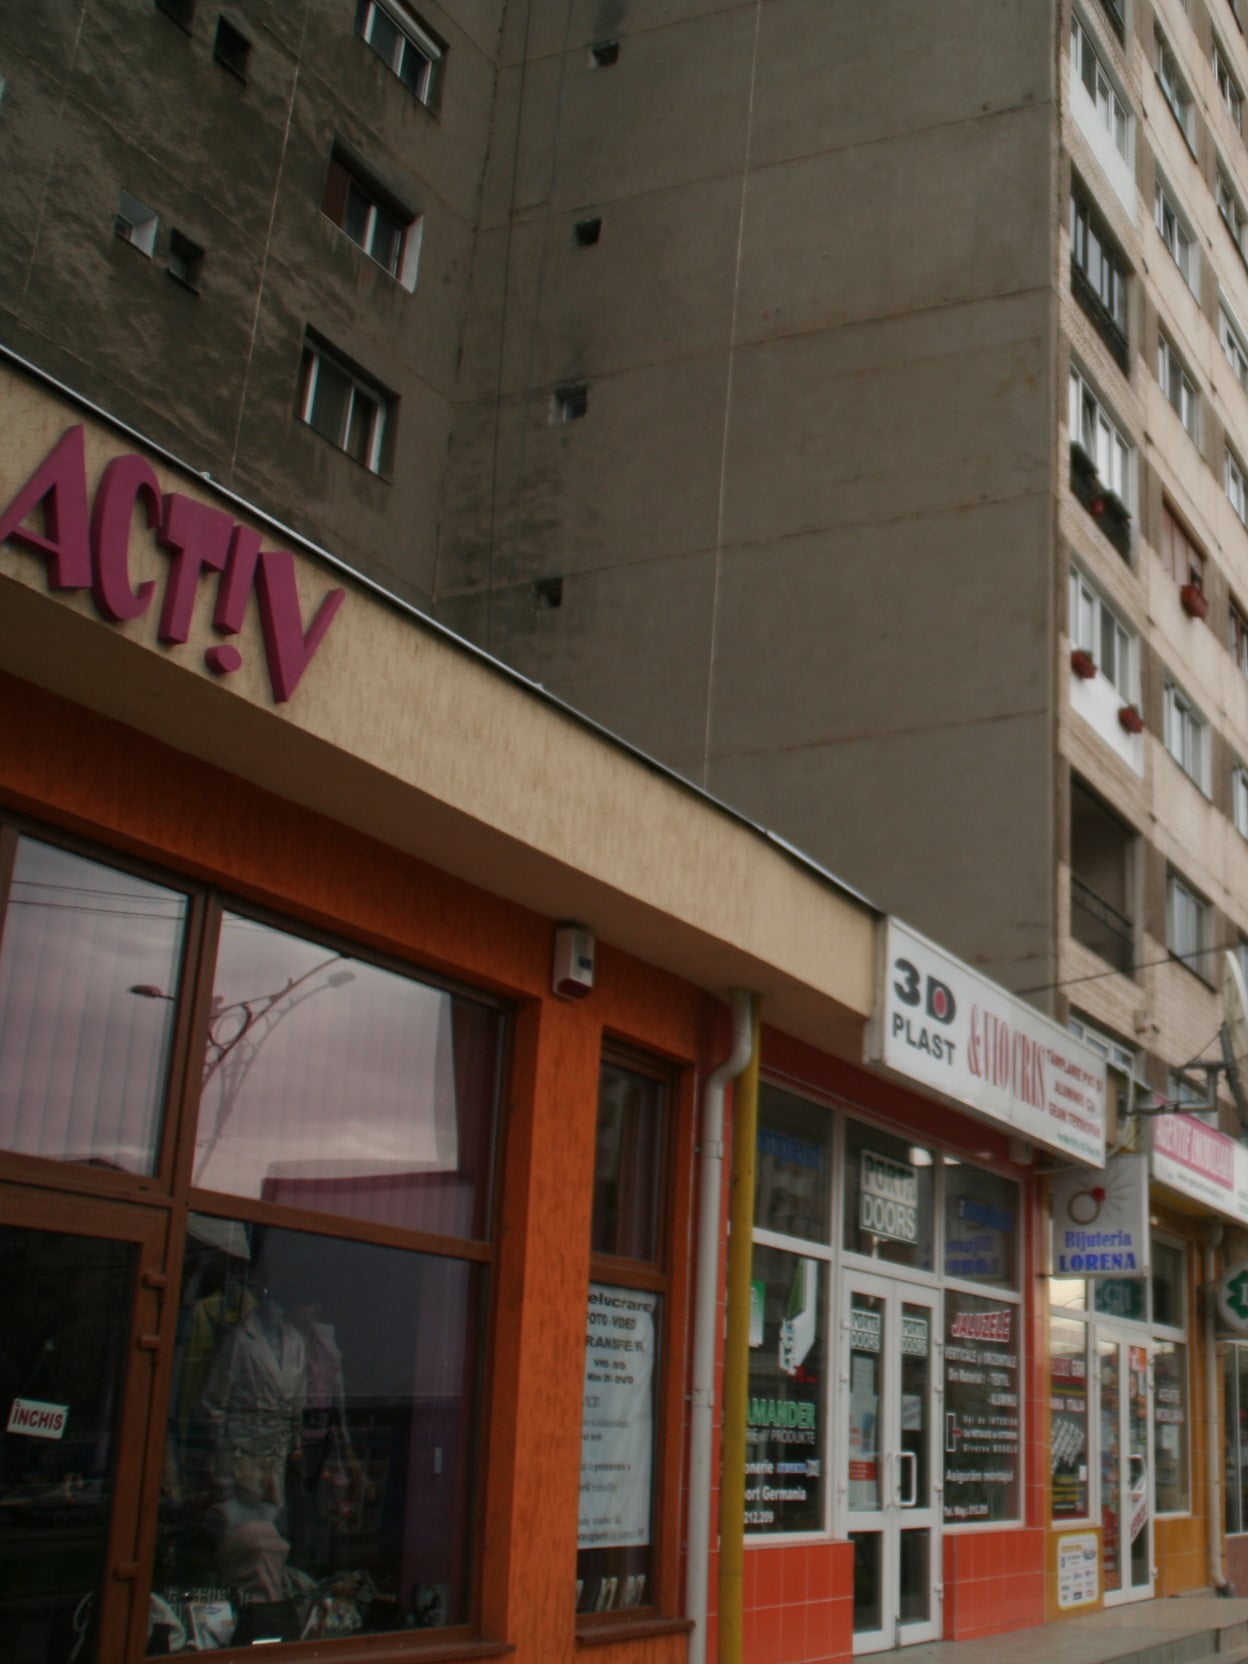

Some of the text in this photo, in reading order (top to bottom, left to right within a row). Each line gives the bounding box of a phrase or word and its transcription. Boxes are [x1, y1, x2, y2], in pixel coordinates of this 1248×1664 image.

[894, 958, 956, 1025] 3D
[893, 1011, 955, 1065] PLAST
[863, 1193, 917, 1240] DOORS
[1064, 1230, 1133, 1252] Bijuteria
[1058, 1252, 1137, 1272] LORENA
[951, 1310, 1010, 1342] JALUZELE
[762, 1486, 807, 1501] Germania
